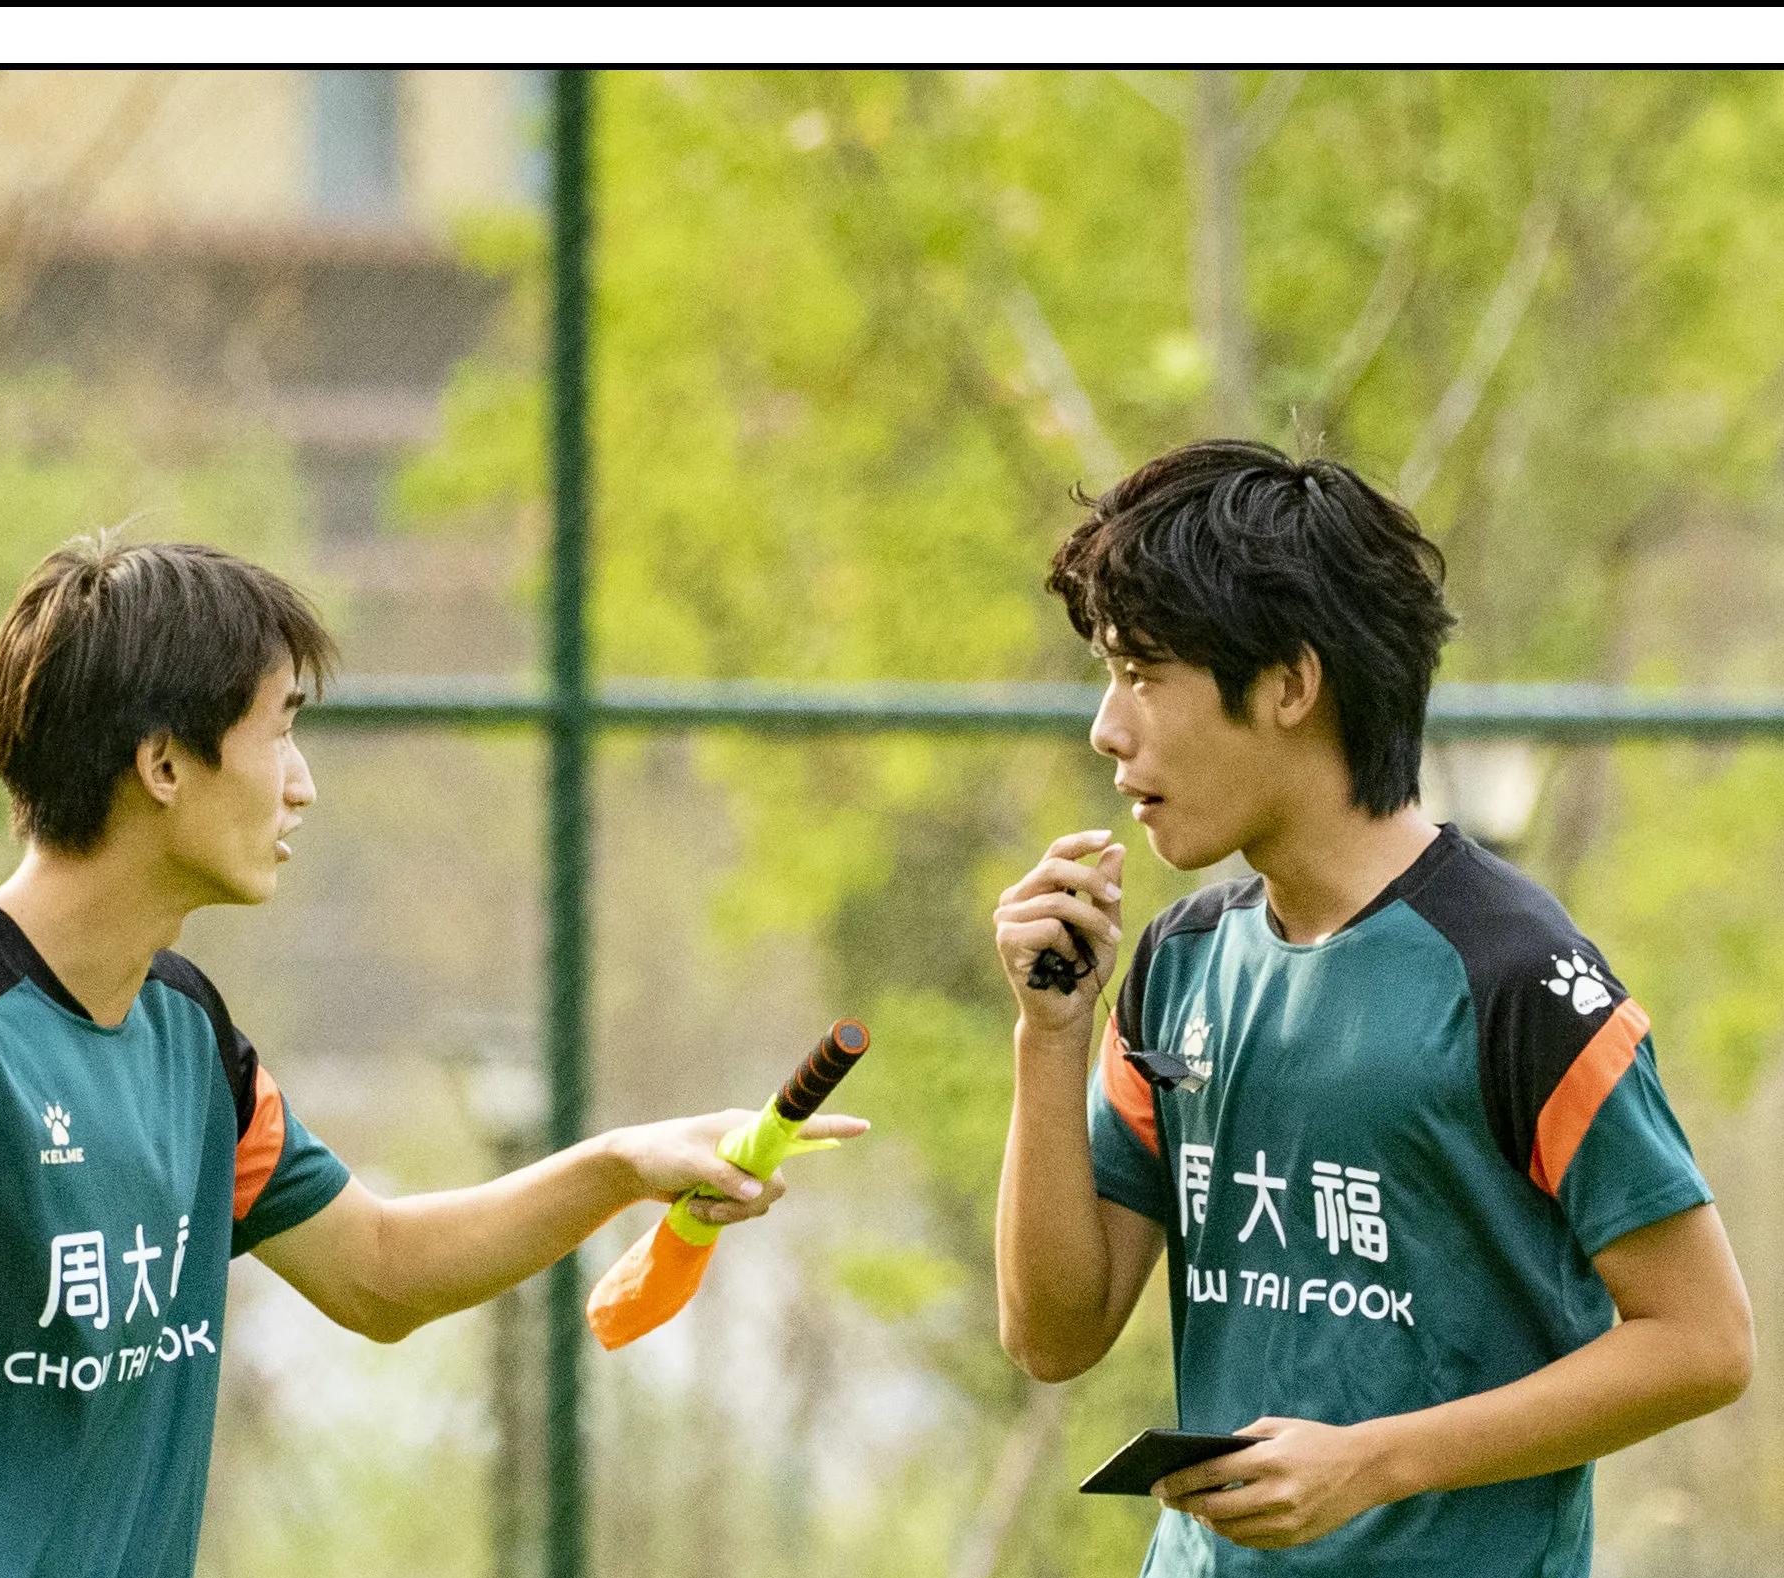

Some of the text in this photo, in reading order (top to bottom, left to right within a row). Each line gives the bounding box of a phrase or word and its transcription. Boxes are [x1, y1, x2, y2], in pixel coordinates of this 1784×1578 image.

[40, 1147, 85, 1165] KELME
[1240, 1270, 1290, 1311] TAI
[1298, 1279, 1415, 1327] FOOK
